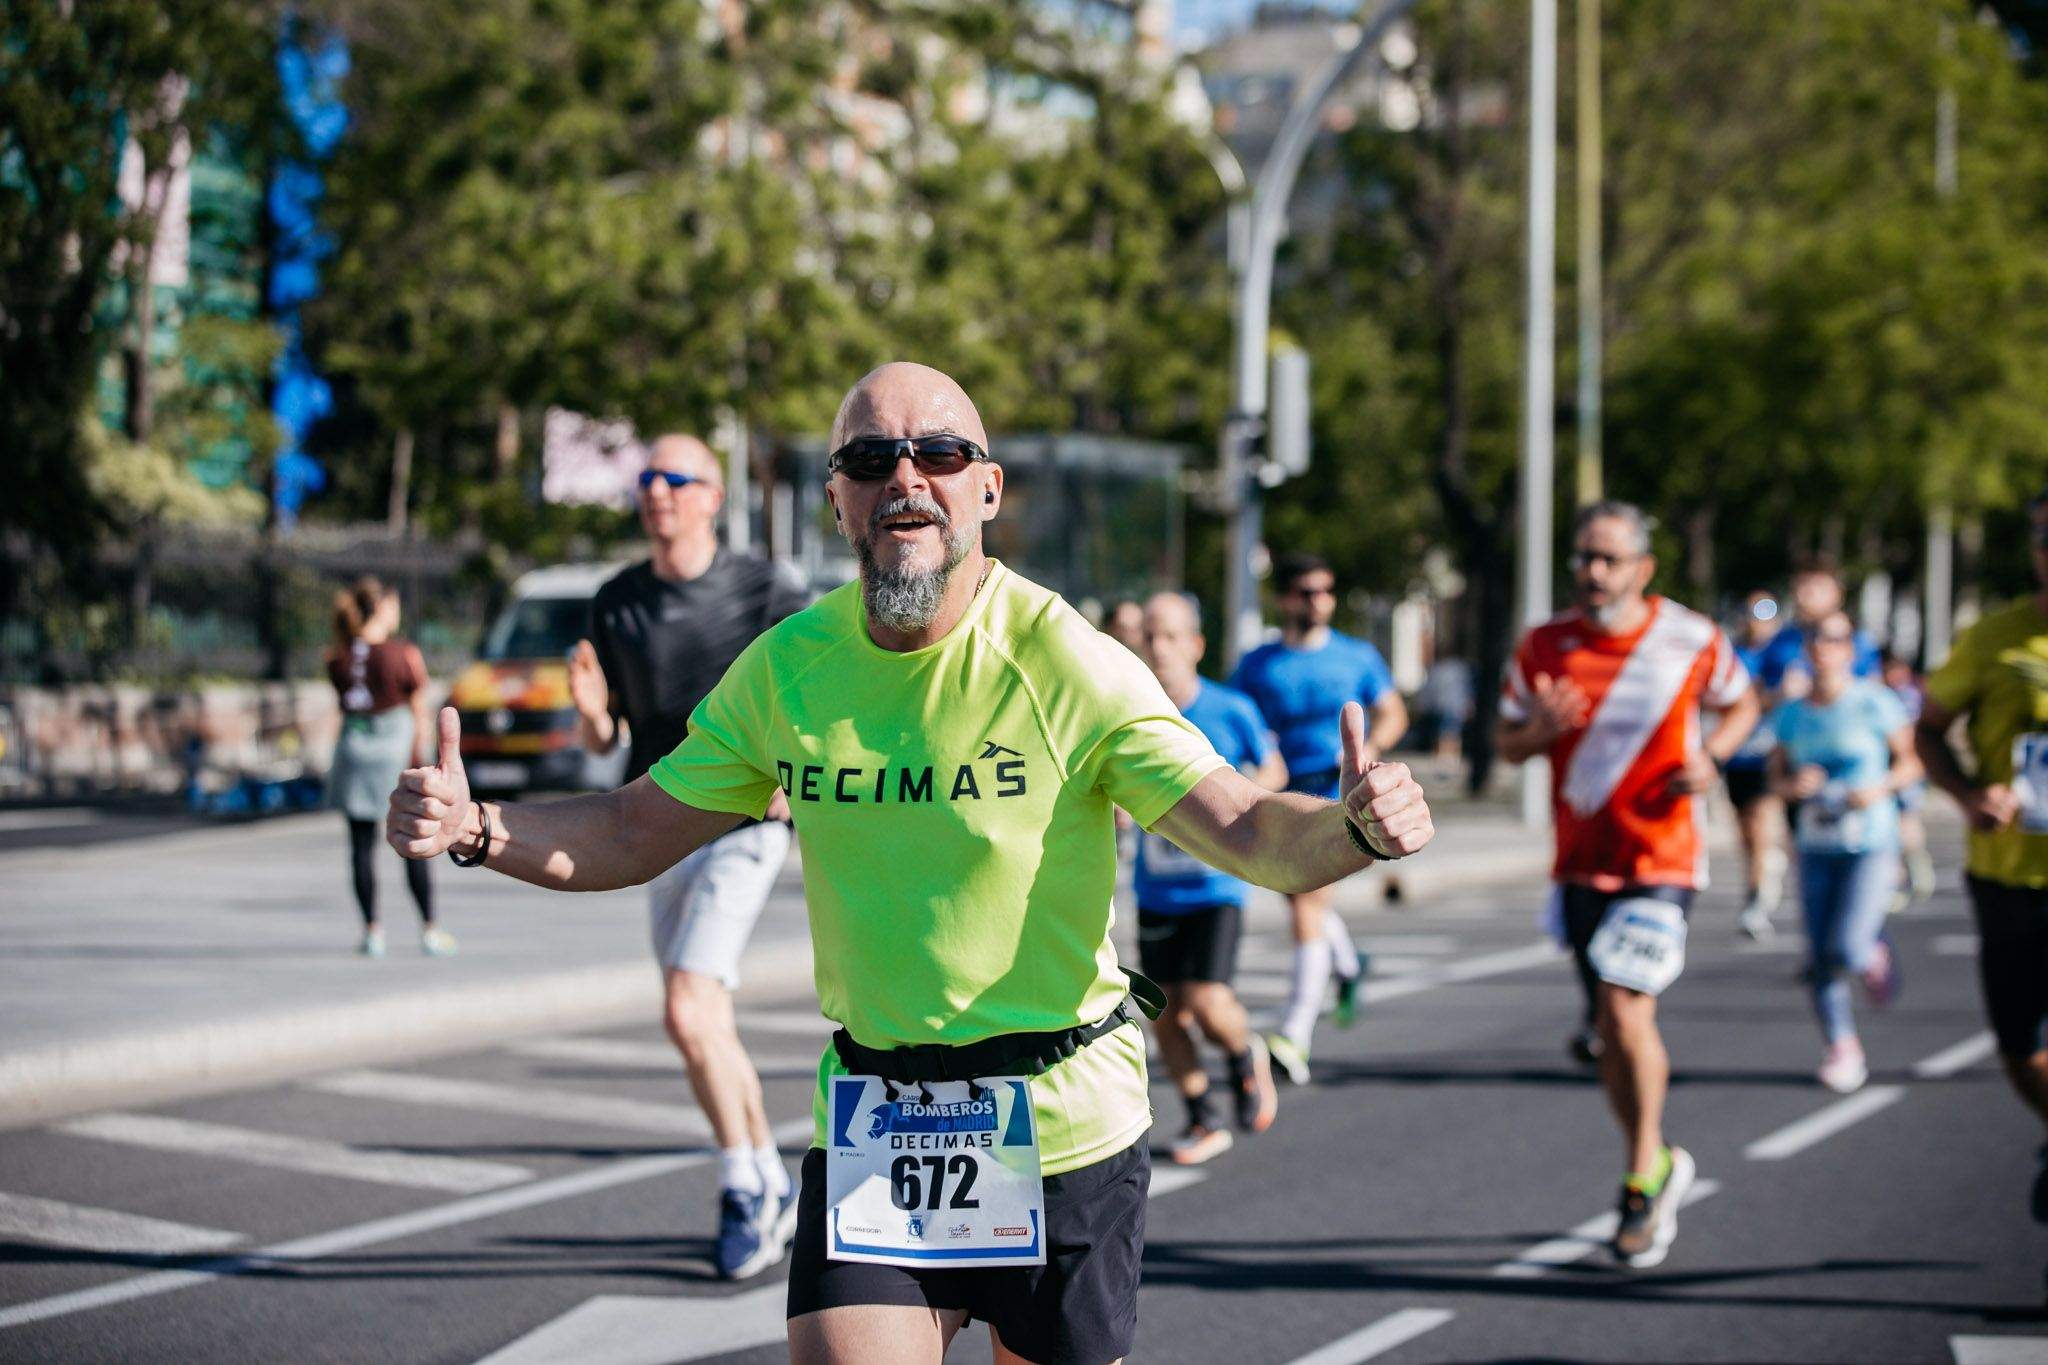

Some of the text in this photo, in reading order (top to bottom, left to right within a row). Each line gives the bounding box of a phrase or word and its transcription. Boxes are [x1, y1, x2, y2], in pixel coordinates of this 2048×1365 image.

[777, 759, 1027, 803] DECIMAS
[901, 1101, 994, 1117] BOMBEROS
[937, 1115, 995, 1132] de MADRID
[891, 1132, 993, 1149] DECIMAS
[890, 1154, 979, 1211] 672
